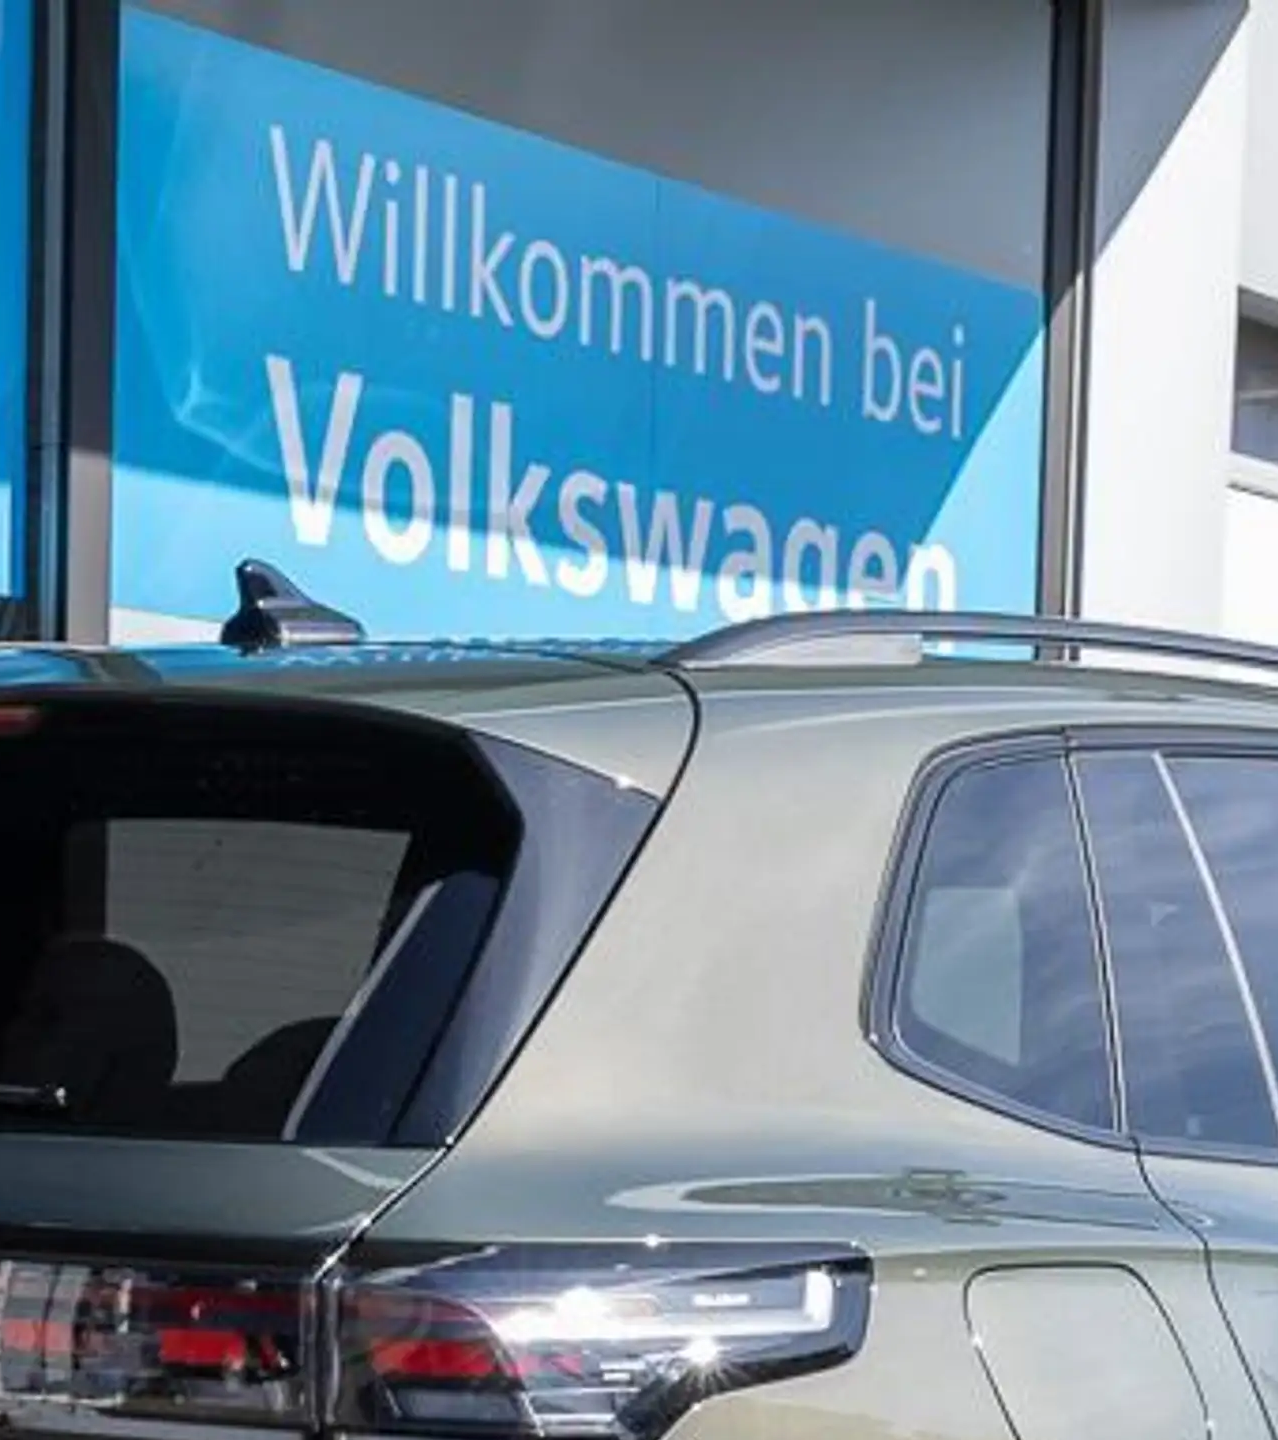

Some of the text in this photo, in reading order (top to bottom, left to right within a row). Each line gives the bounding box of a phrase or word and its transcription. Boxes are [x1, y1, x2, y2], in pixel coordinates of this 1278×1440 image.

[271, 124, 967, 440] Willkommen bei
[265, 354, 957, 638] Volkswagen
